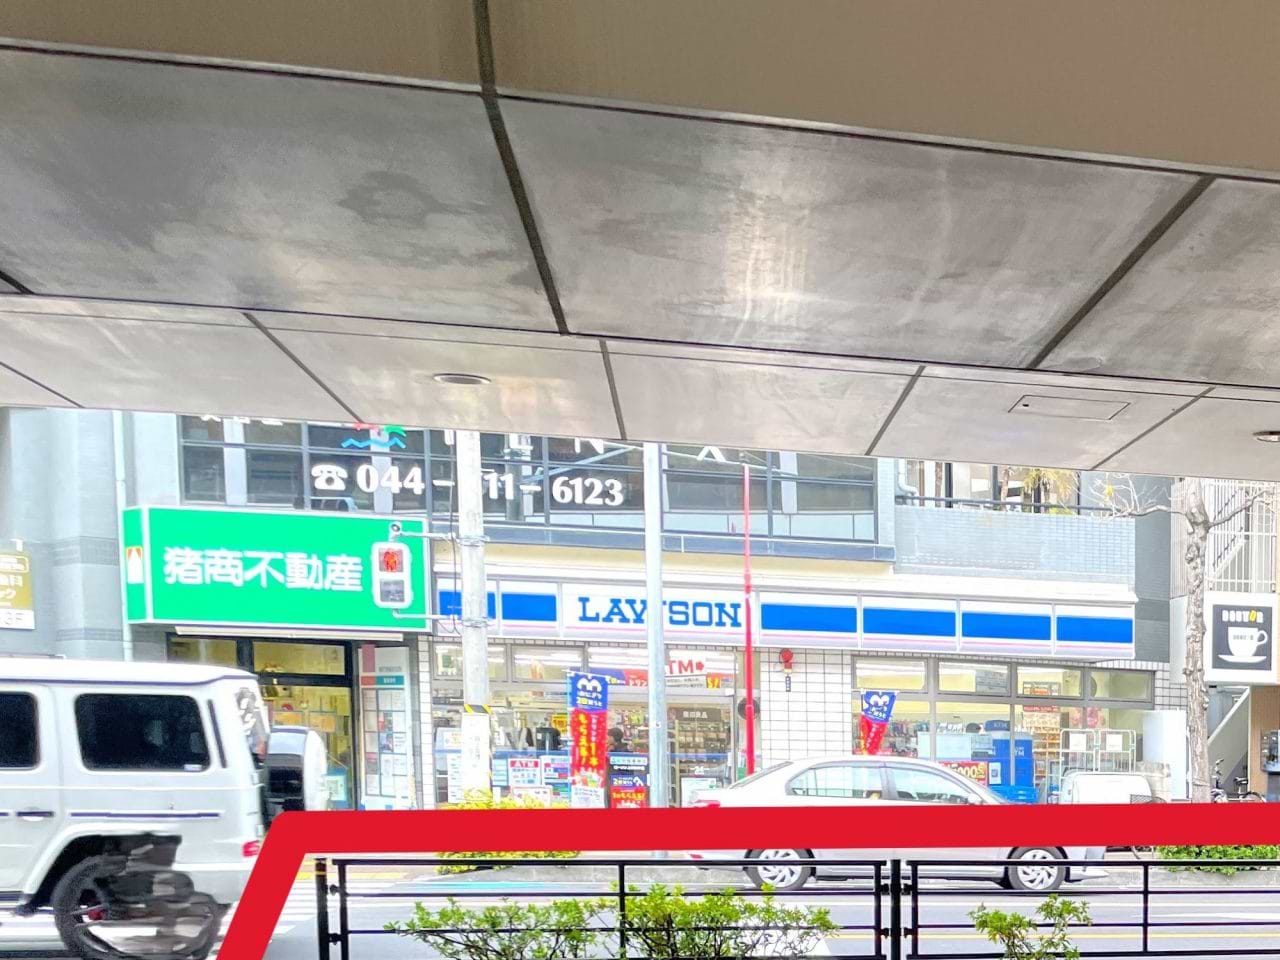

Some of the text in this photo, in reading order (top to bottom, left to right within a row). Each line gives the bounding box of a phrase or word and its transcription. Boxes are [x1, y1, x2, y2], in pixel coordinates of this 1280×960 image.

[356, 464, 624, 506] 044-11-6123
[163, 547, 364, 592] 猪商不動産
